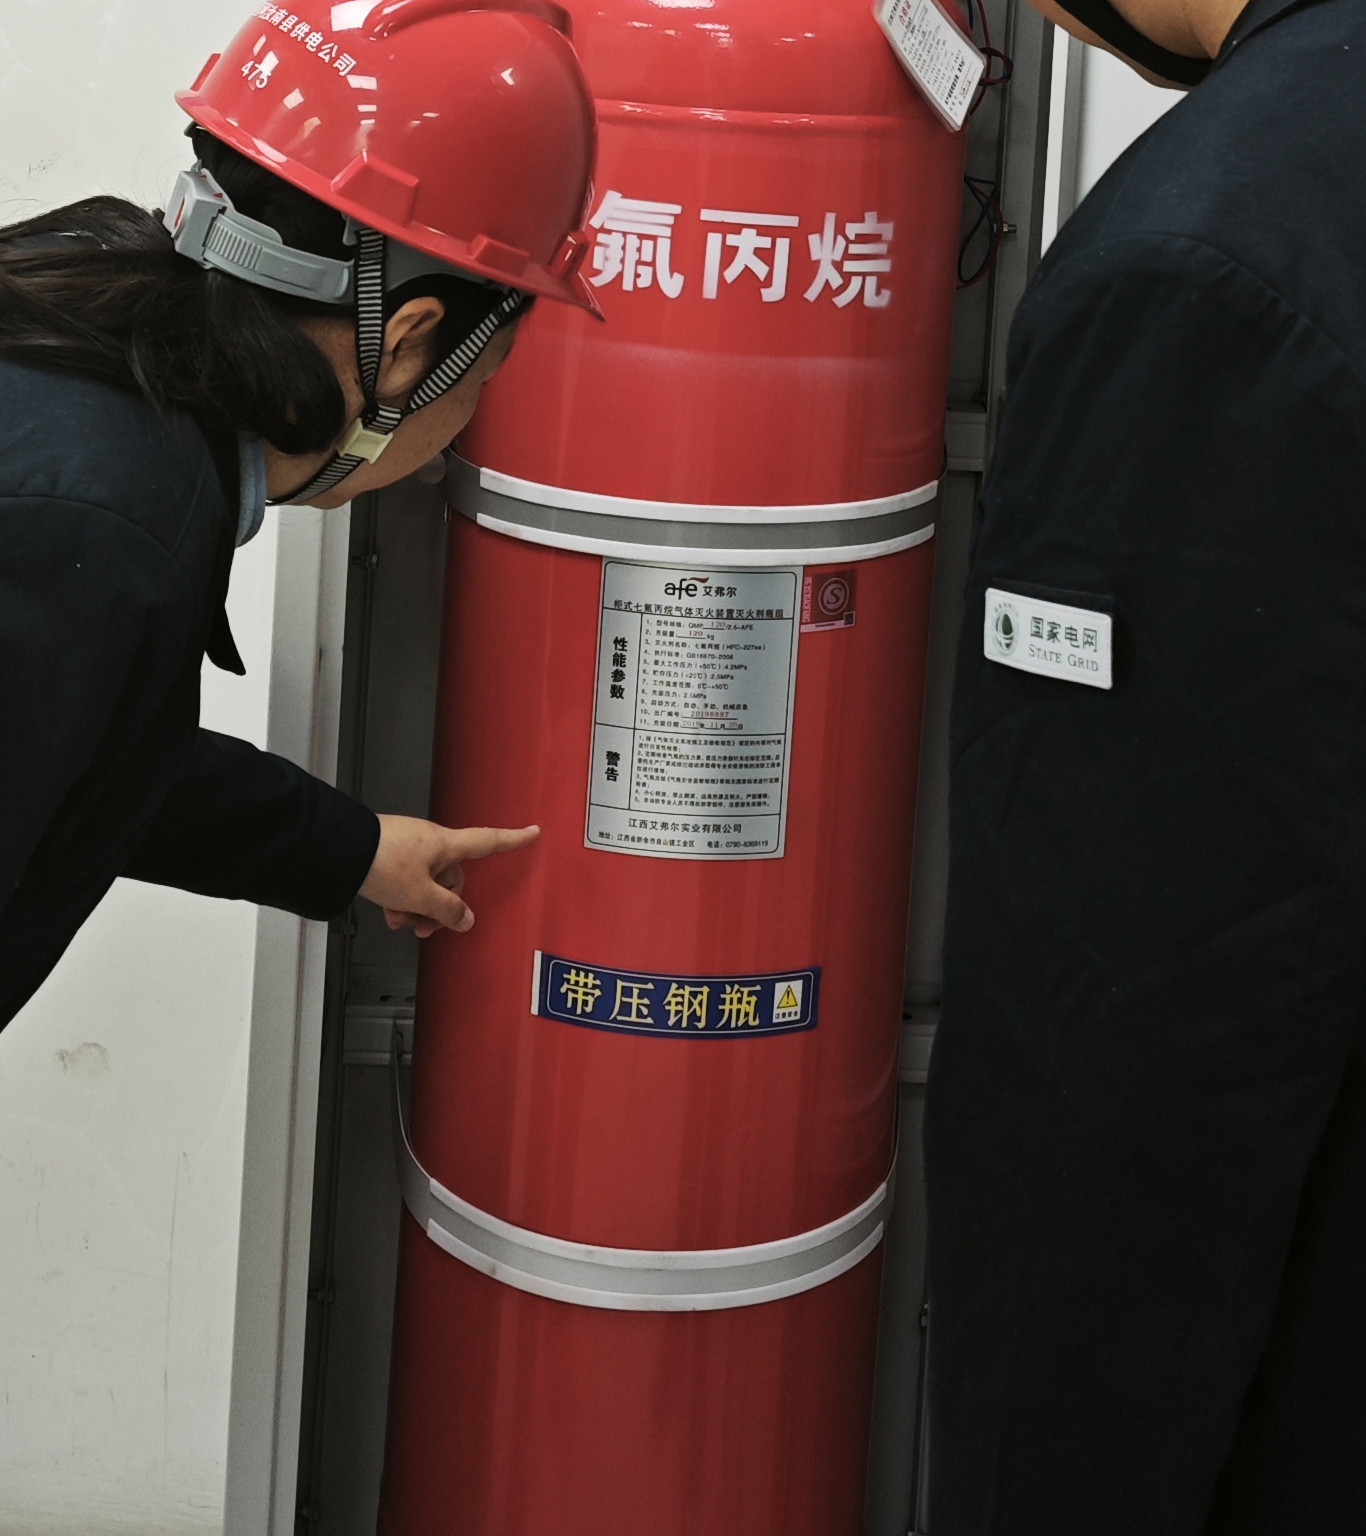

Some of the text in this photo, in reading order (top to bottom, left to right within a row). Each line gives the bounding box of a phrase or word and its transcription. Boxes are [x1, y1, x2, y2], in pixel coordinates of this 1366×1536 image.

[588, 190, 894, 308] 氟丙烷
[702, 585, 737, 598] 艾弗尔
[1030, 615, 1098, 653] 国家电网
[610, 636, 628, 700] 性能参数
[1028, 643, 1099, 672] STATE GRID
[604, 750, 621, 782] 警告
[628, 818, 742, 834] 江西艾弗尔实业有限公司
[560, 967, 763, 1030] 带压钢瓶
